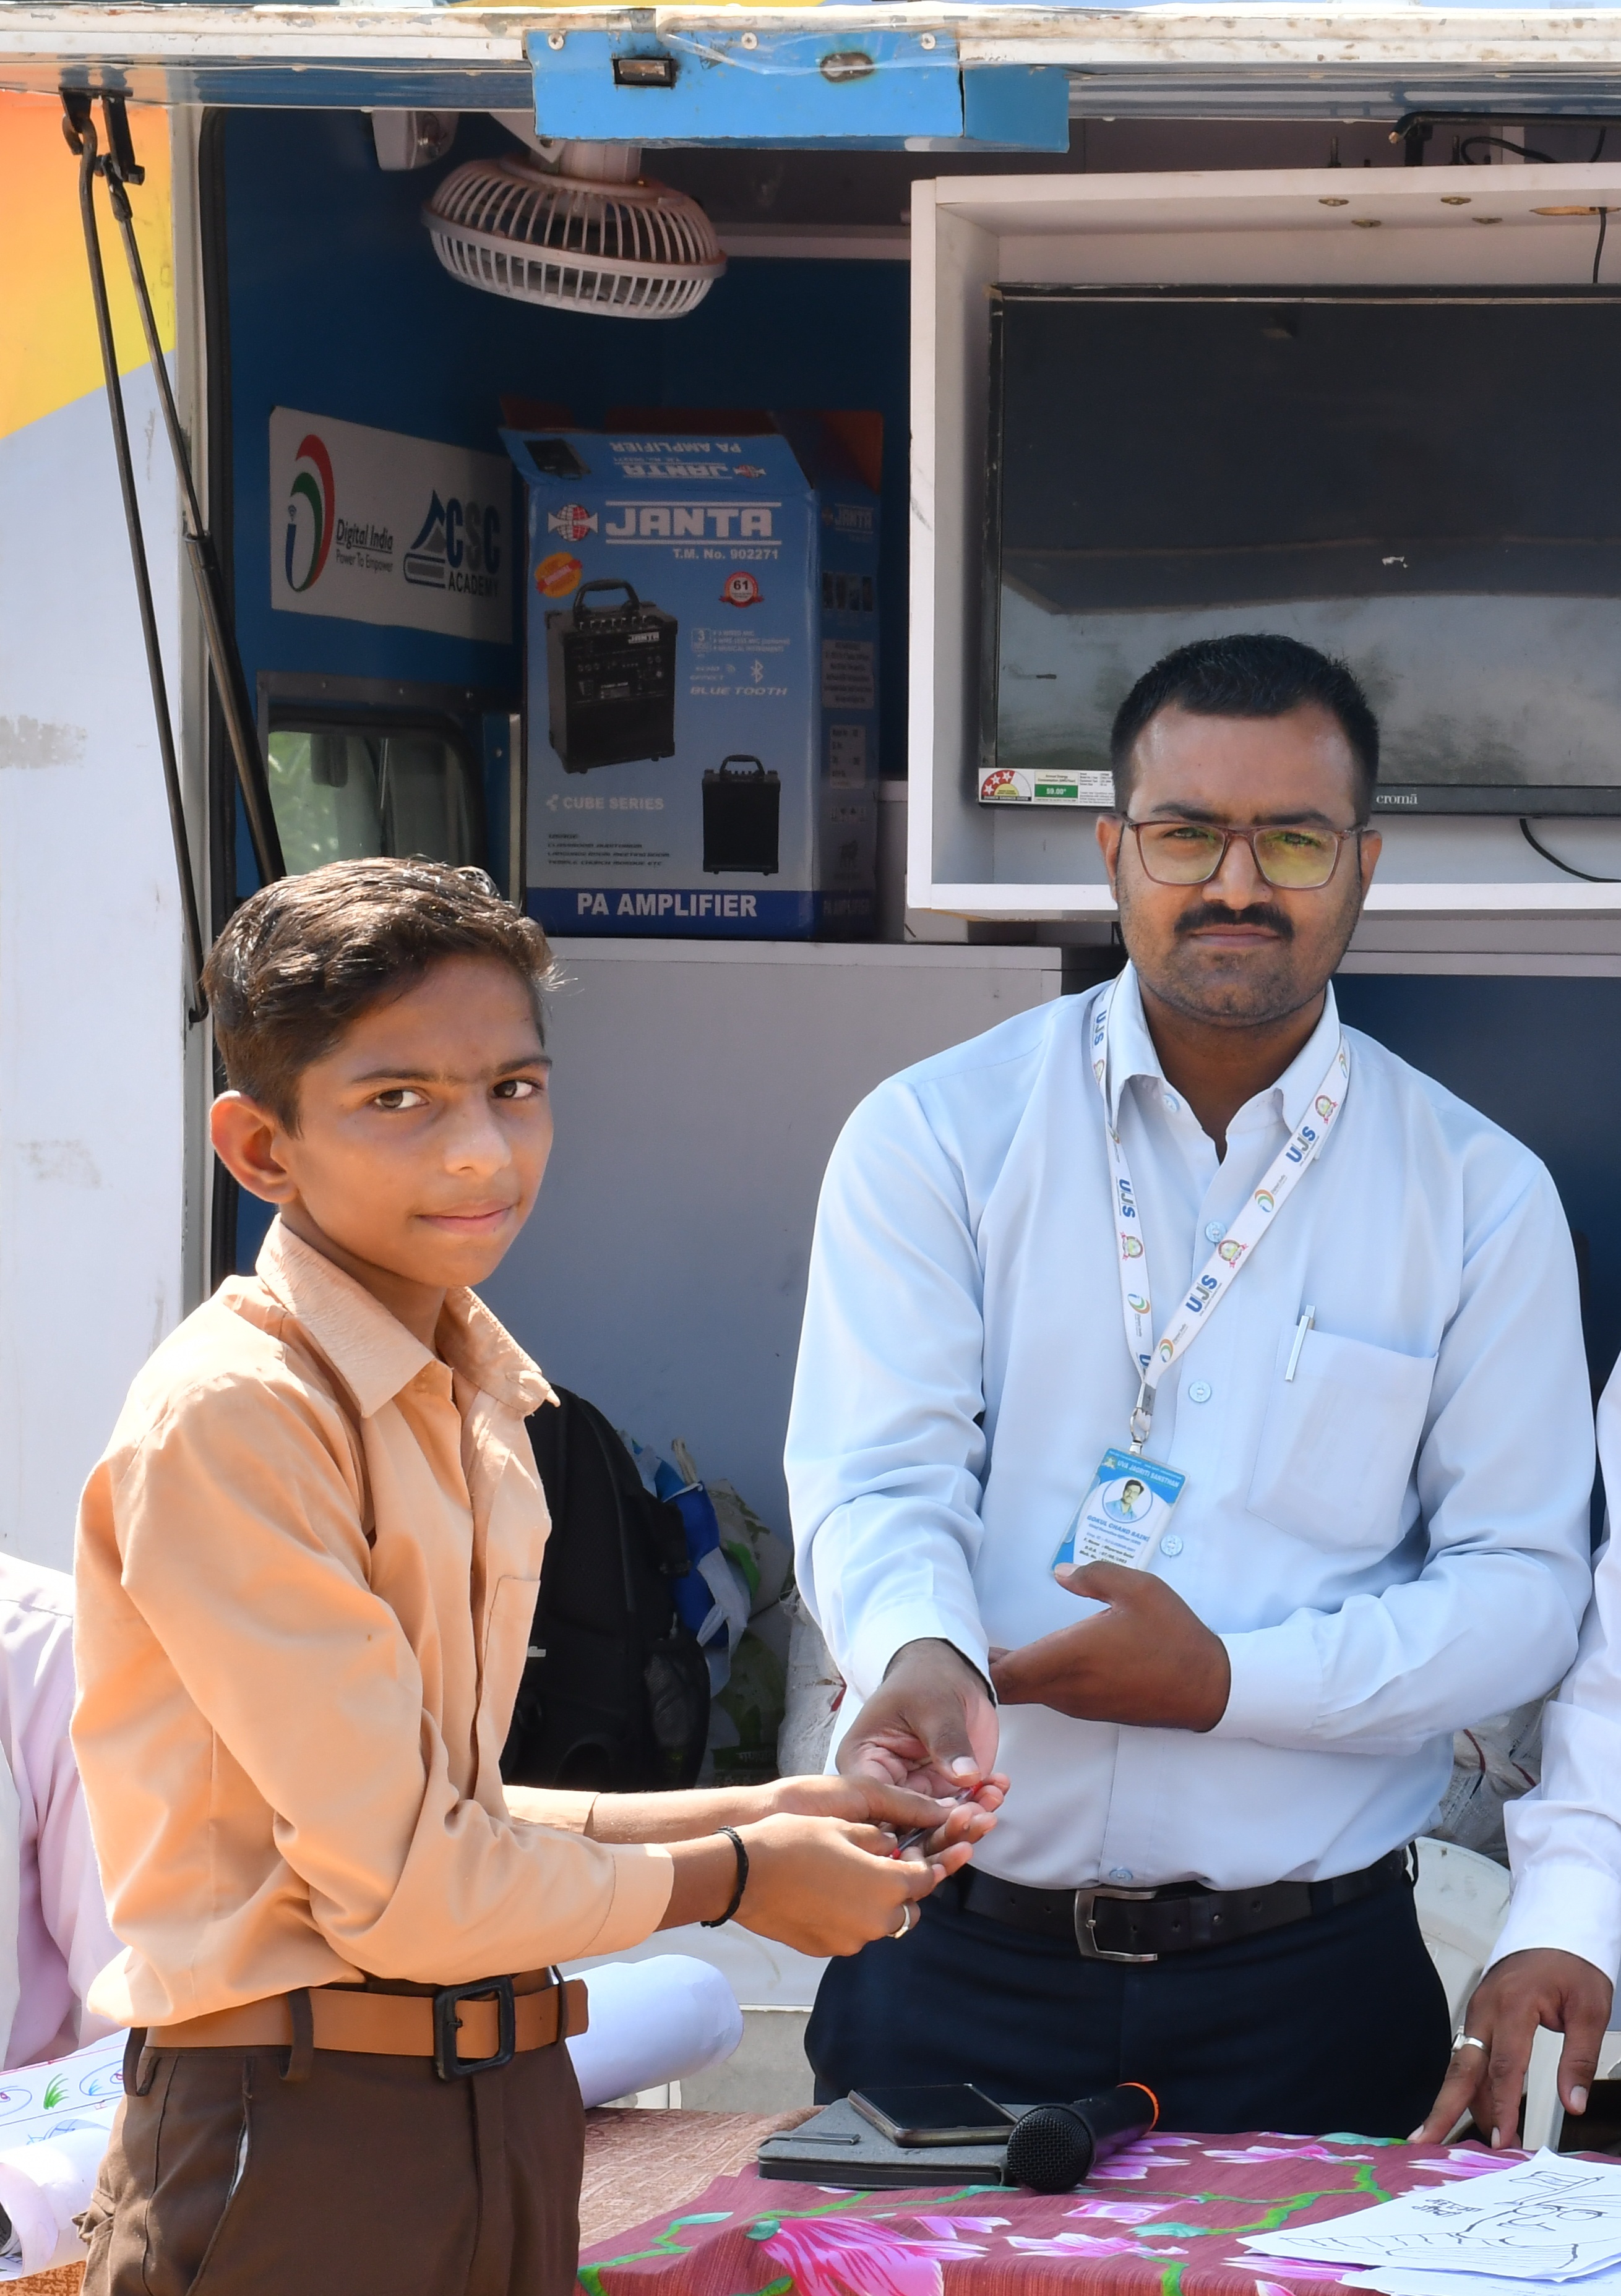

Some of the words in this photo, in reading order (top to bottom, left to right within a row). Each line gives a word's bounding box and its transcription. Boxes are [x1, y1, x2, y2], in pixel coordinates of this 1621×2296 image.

[622, 464, 728, 478] JANTA
[606, 508, 773, 538] JANTA
[336, 518, 368, 548] Digital
[371, 525, 393, 547] India
[445, 497, 500, 575] CSC
[673, 548, 700, 559] T.M.
[703, 548, 726, 559] No.
[730, 549, 779, 560] 902271
[733, 580, 749, 590] 61
[690, 687, 731, 695] BLUE
[734, 687, 788, 695] TOOTH
[562, 797, 604, 810] CUBE
[609, 797, 664, 810] SERIES
[577, 892, 609, 915] PA
[617, 893, 758, 917] AMPLIFIER
